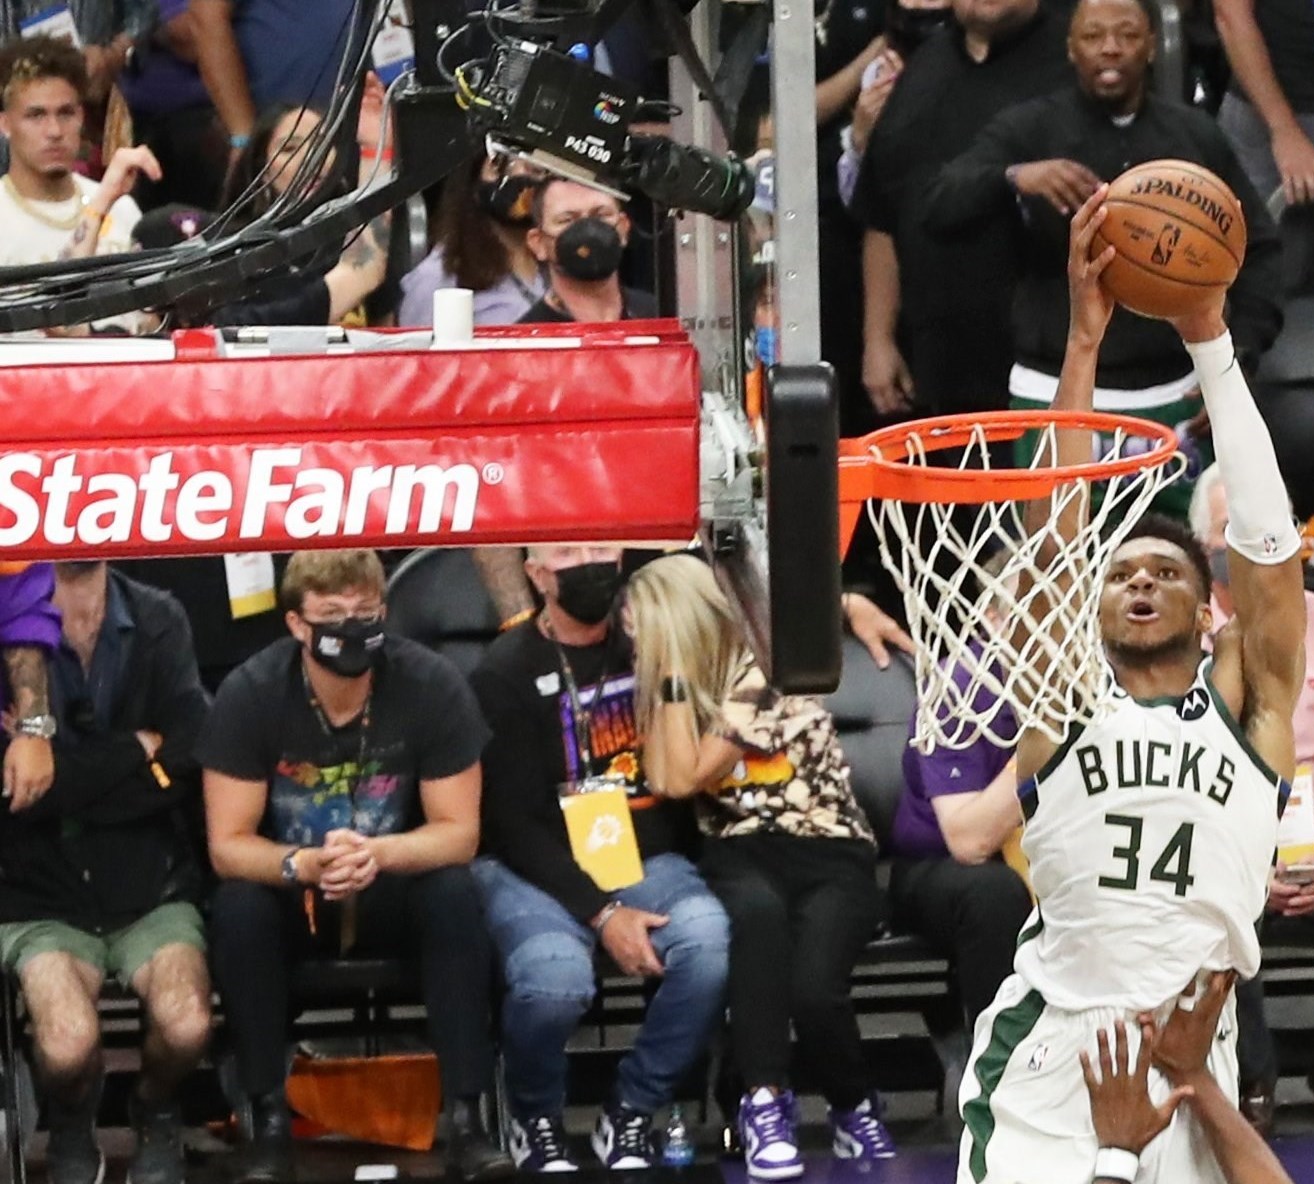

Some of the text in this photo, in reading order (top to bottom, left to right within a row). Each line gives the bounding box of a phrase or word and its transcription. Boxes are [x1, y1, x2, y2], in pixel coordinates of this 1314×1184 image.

[564, 135, 589, 155] P43
[1130, 177, 1233, 236] SPALDING
[1076, 740, 1236, 807] BUCKS
[1098, 813, 1195, 897] 34
